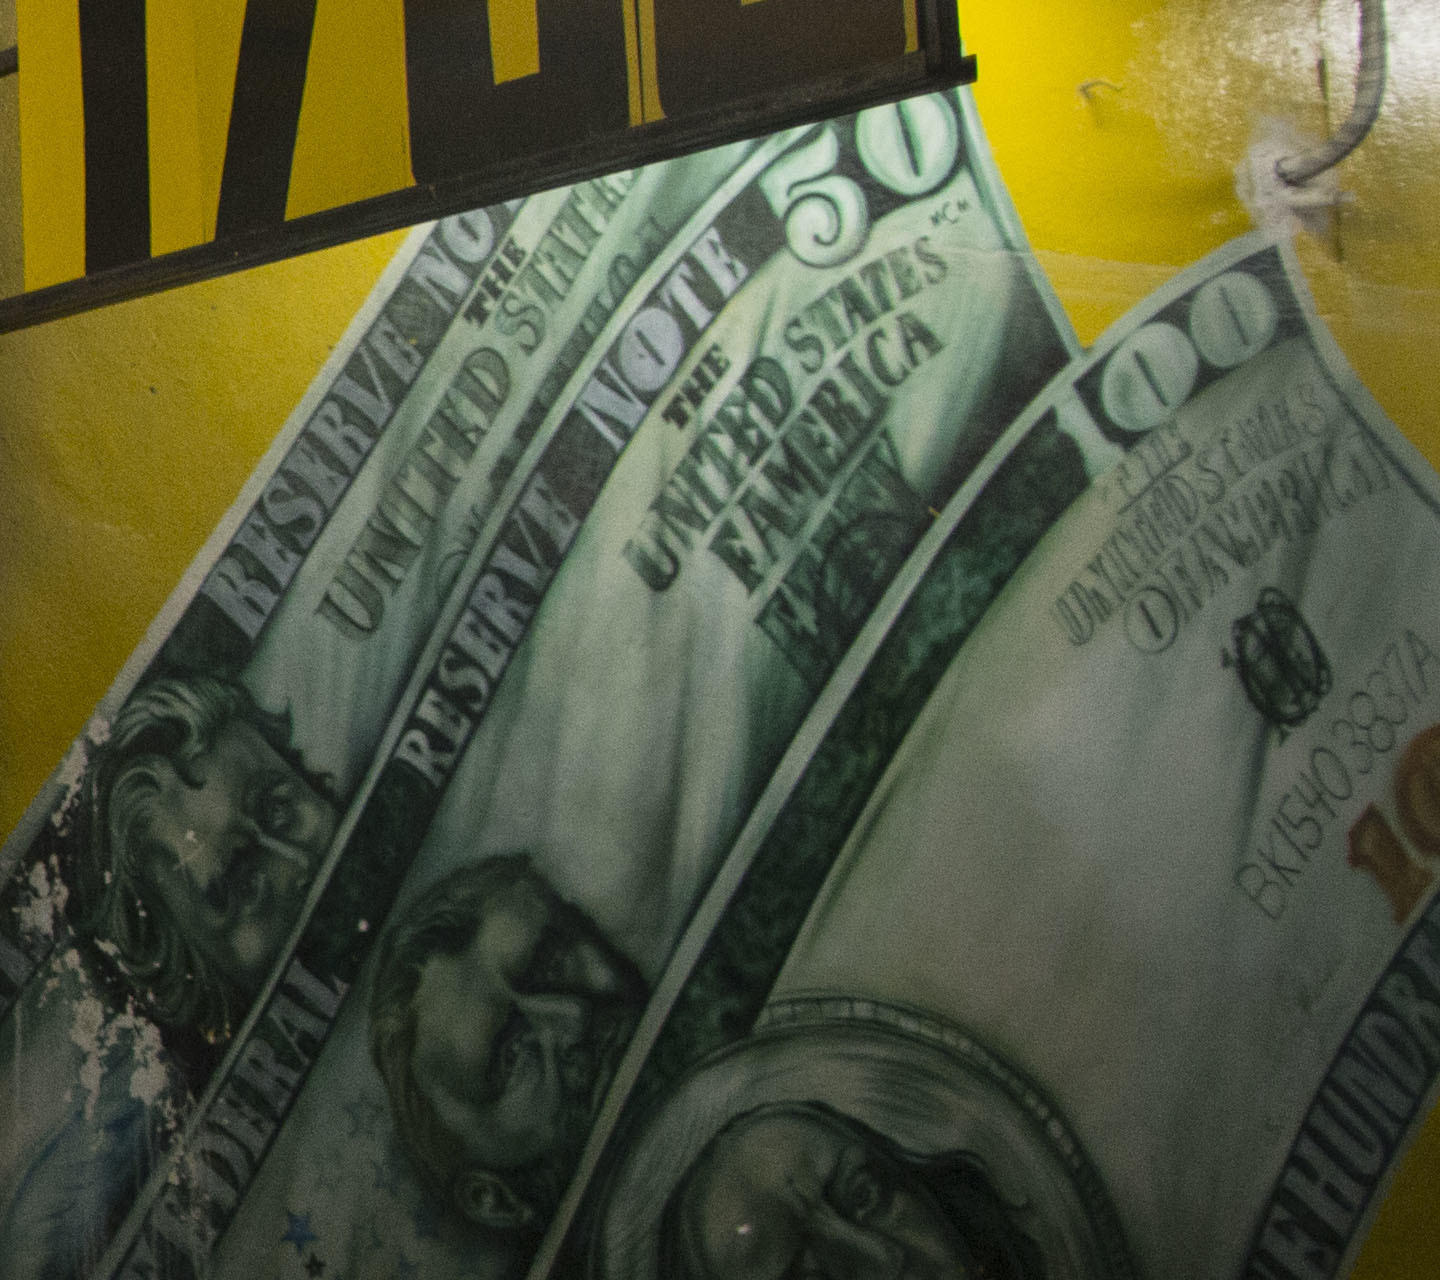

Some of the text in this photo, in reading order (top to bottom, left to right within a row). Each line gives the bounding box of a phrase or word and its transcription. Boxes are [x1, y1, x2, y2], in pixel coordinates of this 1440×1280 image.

[463, 237, 526, 332] THE
[757, 87, 961, 269] 50
[201, 197, 525, 643] RESERVE NO
[316, 345, 512, 643] UNITED
[621, 235, 951, 596] UNITED STATES
[662, 340, 734, 433] THE
[1054, 270, 1278, 490] 100
[393, 474, 583, 792] RESERVE
[576, 228, 750, 452] NOTE
